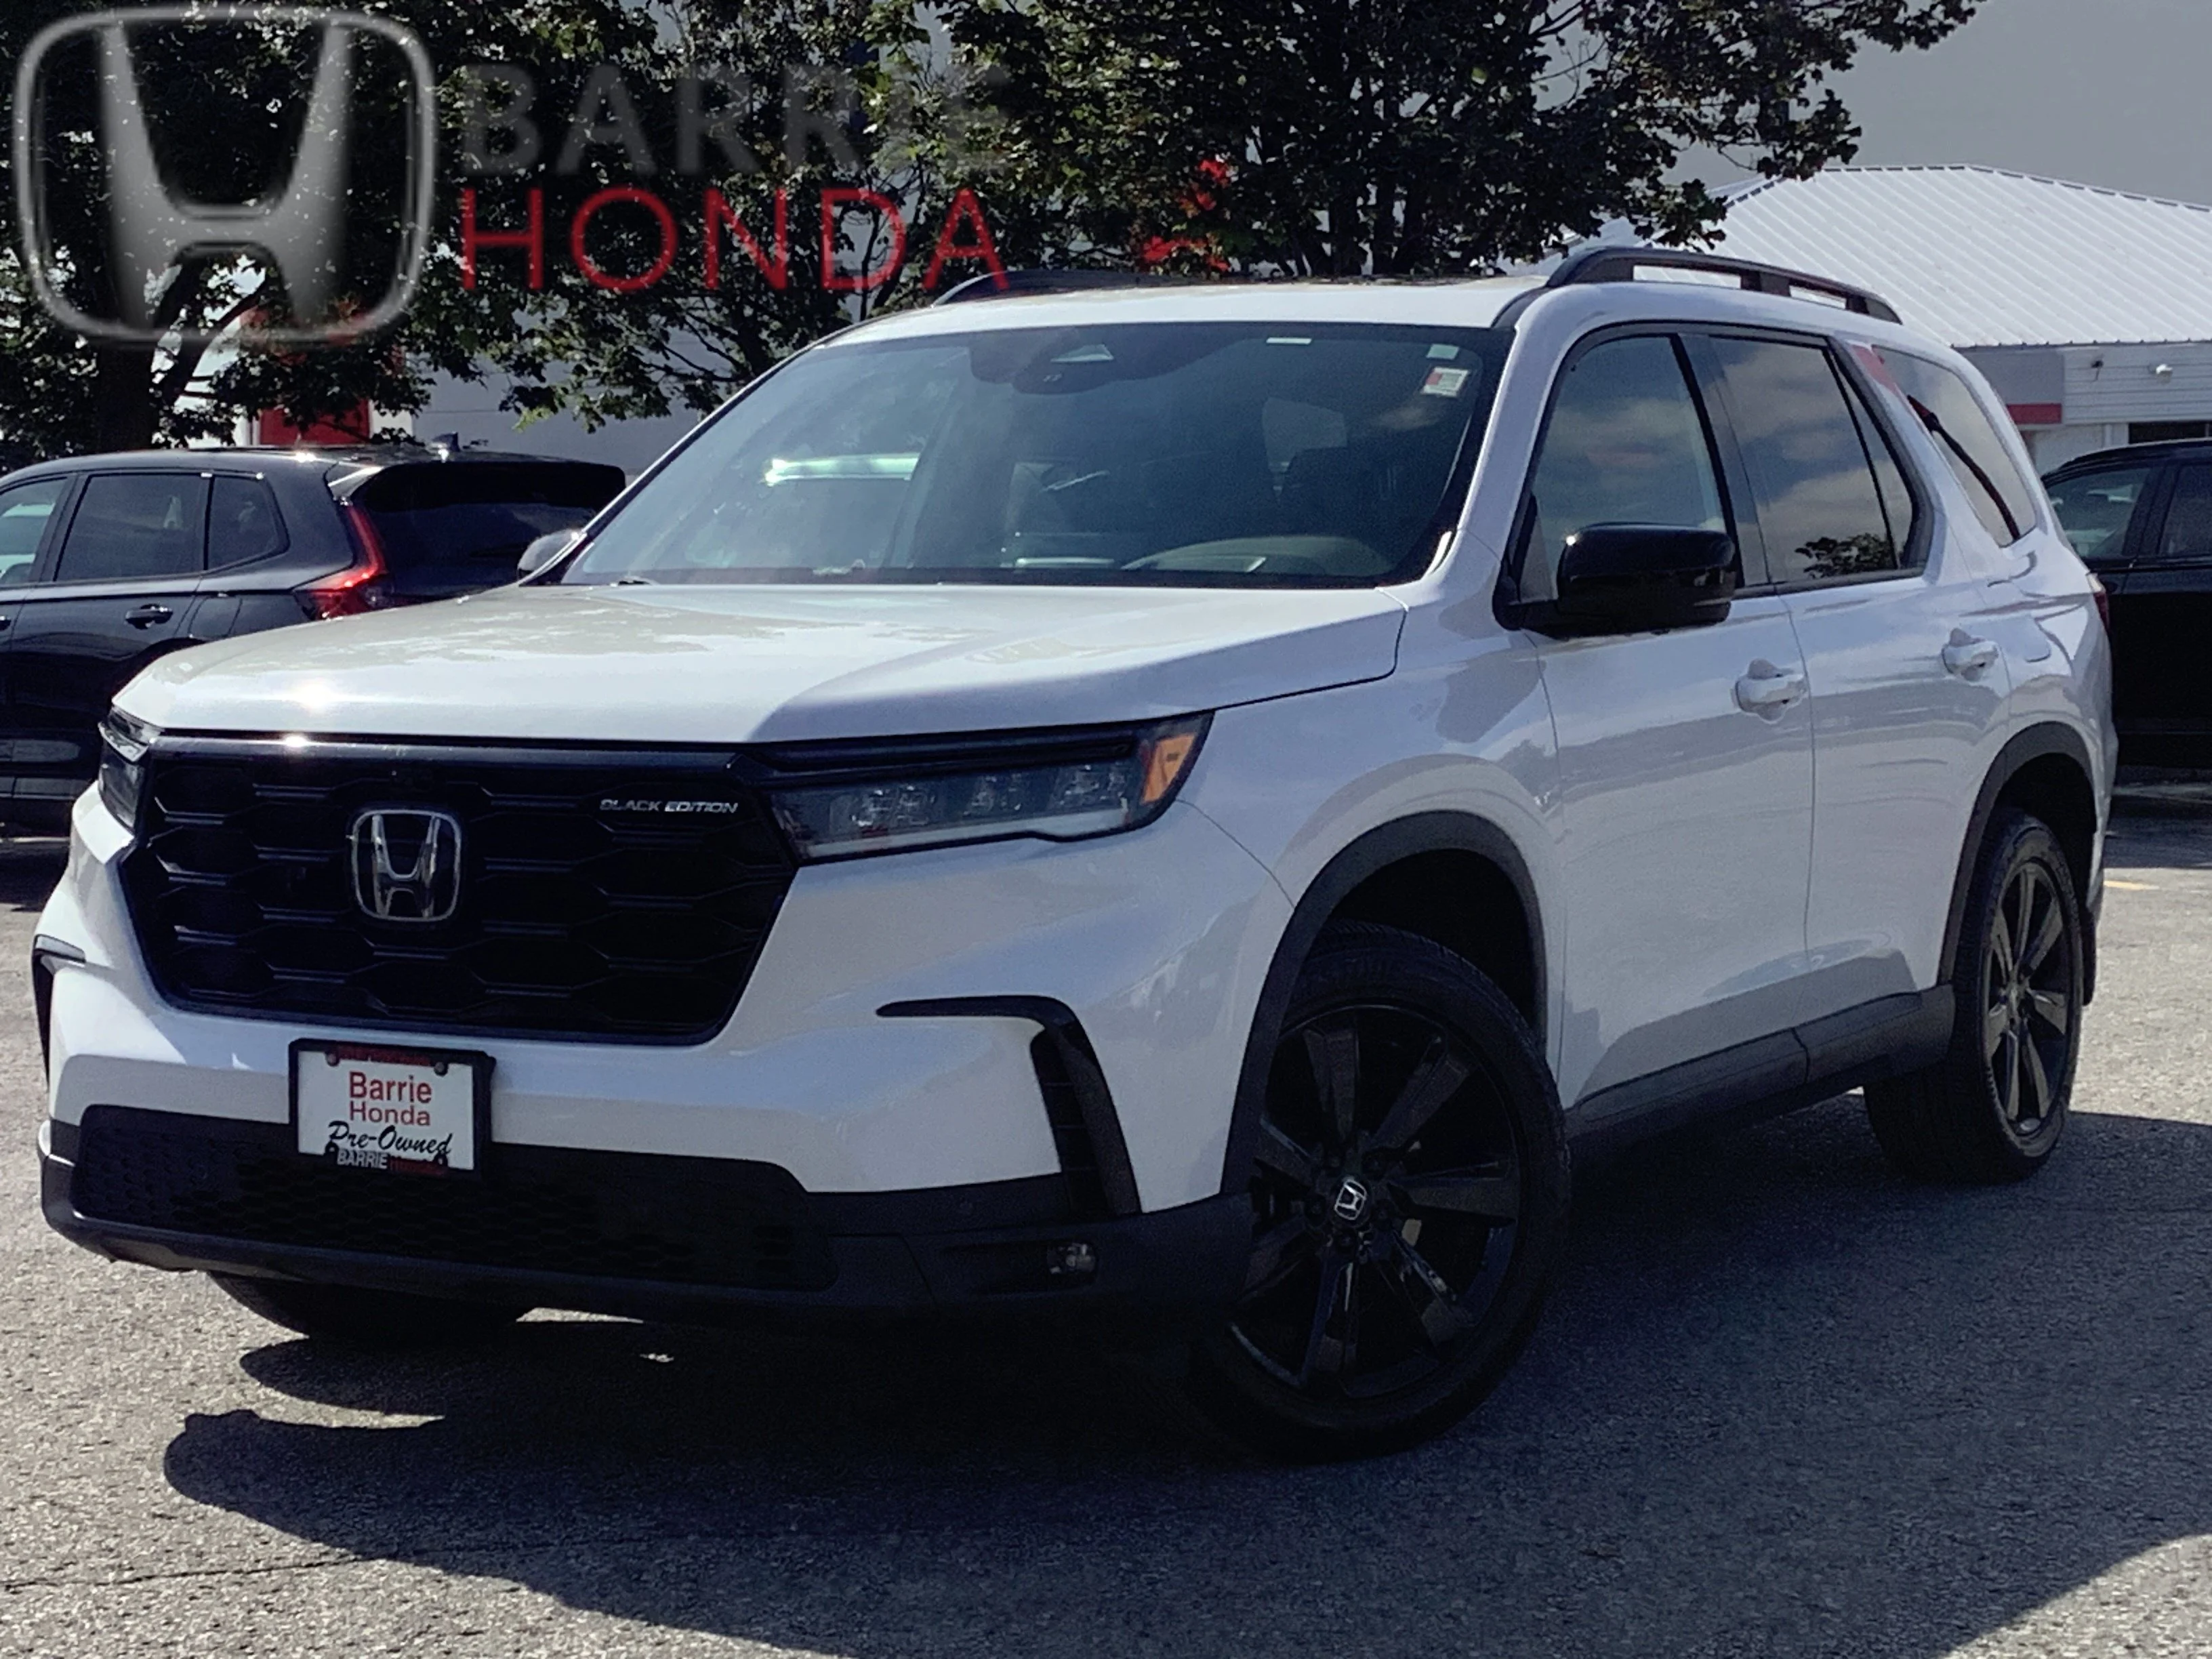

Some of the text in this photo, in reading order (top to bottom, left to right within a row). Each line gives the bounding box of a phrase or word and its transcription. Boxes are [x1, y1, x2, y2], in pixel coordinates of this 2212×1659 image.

[600, 799, 738, 813] BLACK EDITION
[349, 1071, 432, 1103] Barrie
[349, 1101, 430, 1126] Honda
[328, 1120, 453, 1155] Pre-Owned
[337, 1150, 388, 1169] BARRIE
